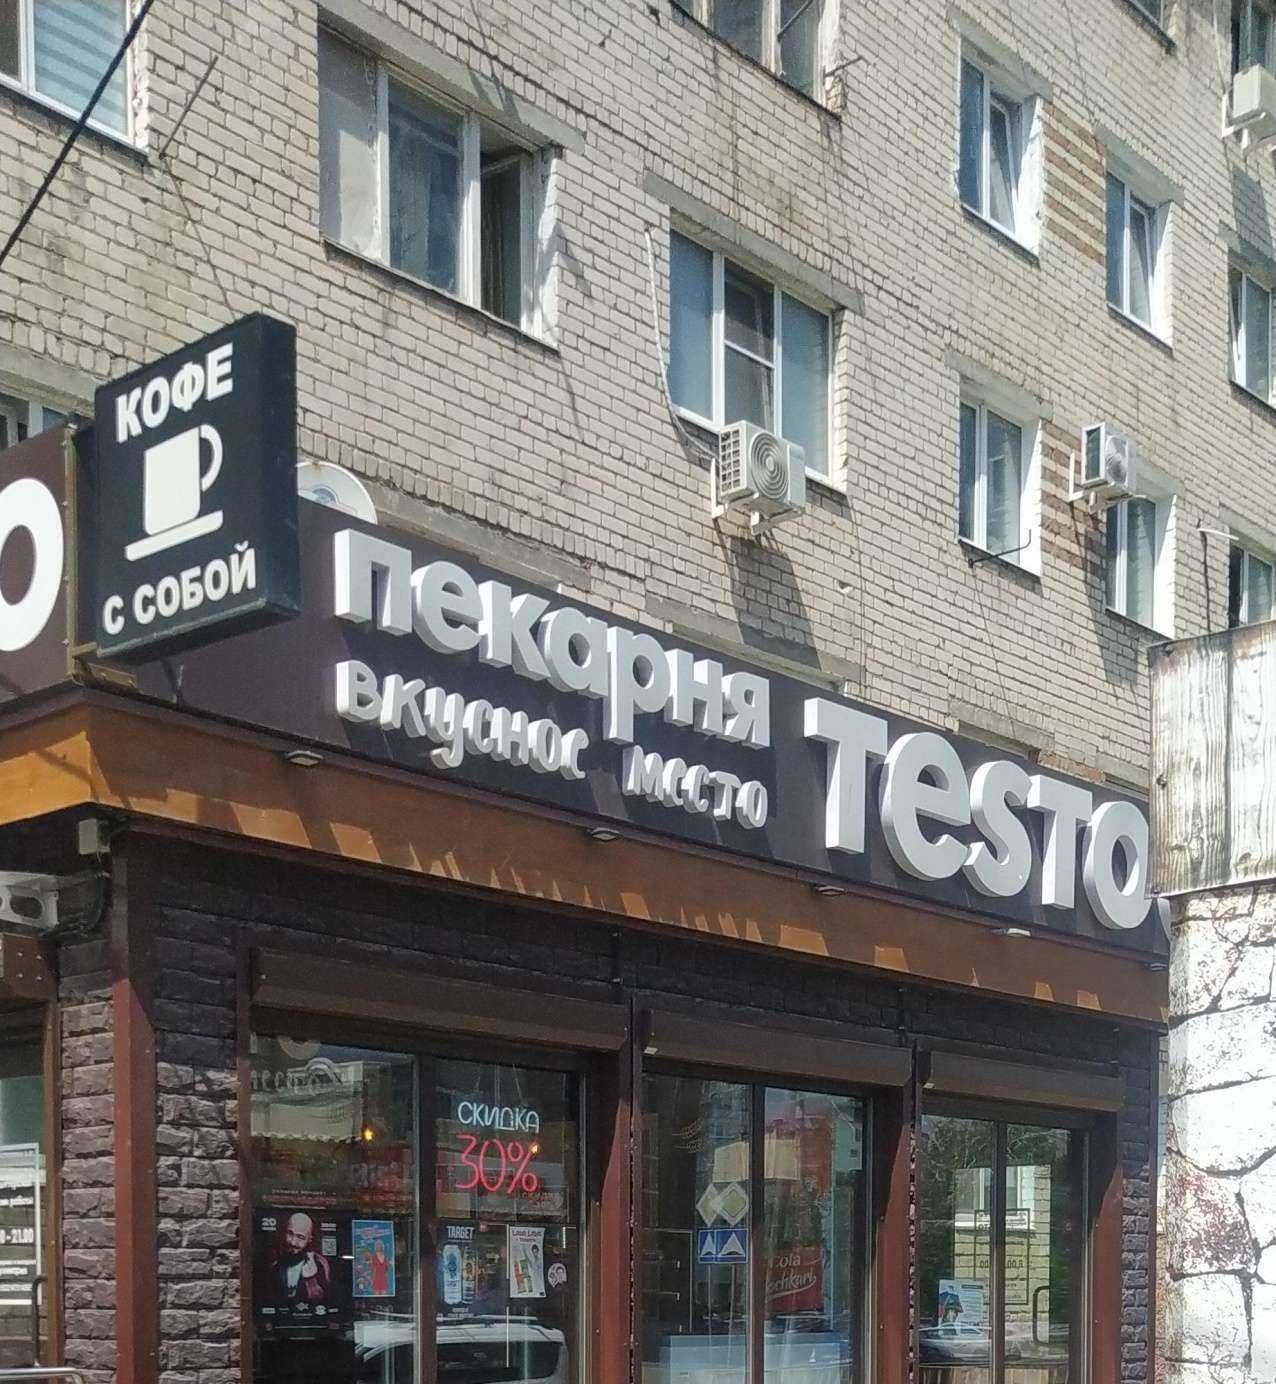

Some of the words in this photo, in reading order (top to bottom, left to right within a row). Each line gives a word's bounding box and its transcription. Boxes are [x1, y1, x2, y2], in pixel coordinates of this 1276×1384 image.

[115, 343, 234, 444] КОФЕ
[134, 540, 257, 627] СОБОЙ
[334, 528, 770, 749] пекарня
[457, 1101, 540, 1134] СКИДКА
[455, 1133, 539, 1194] 30%
[446, 1225, 475, 1240] TARGET
